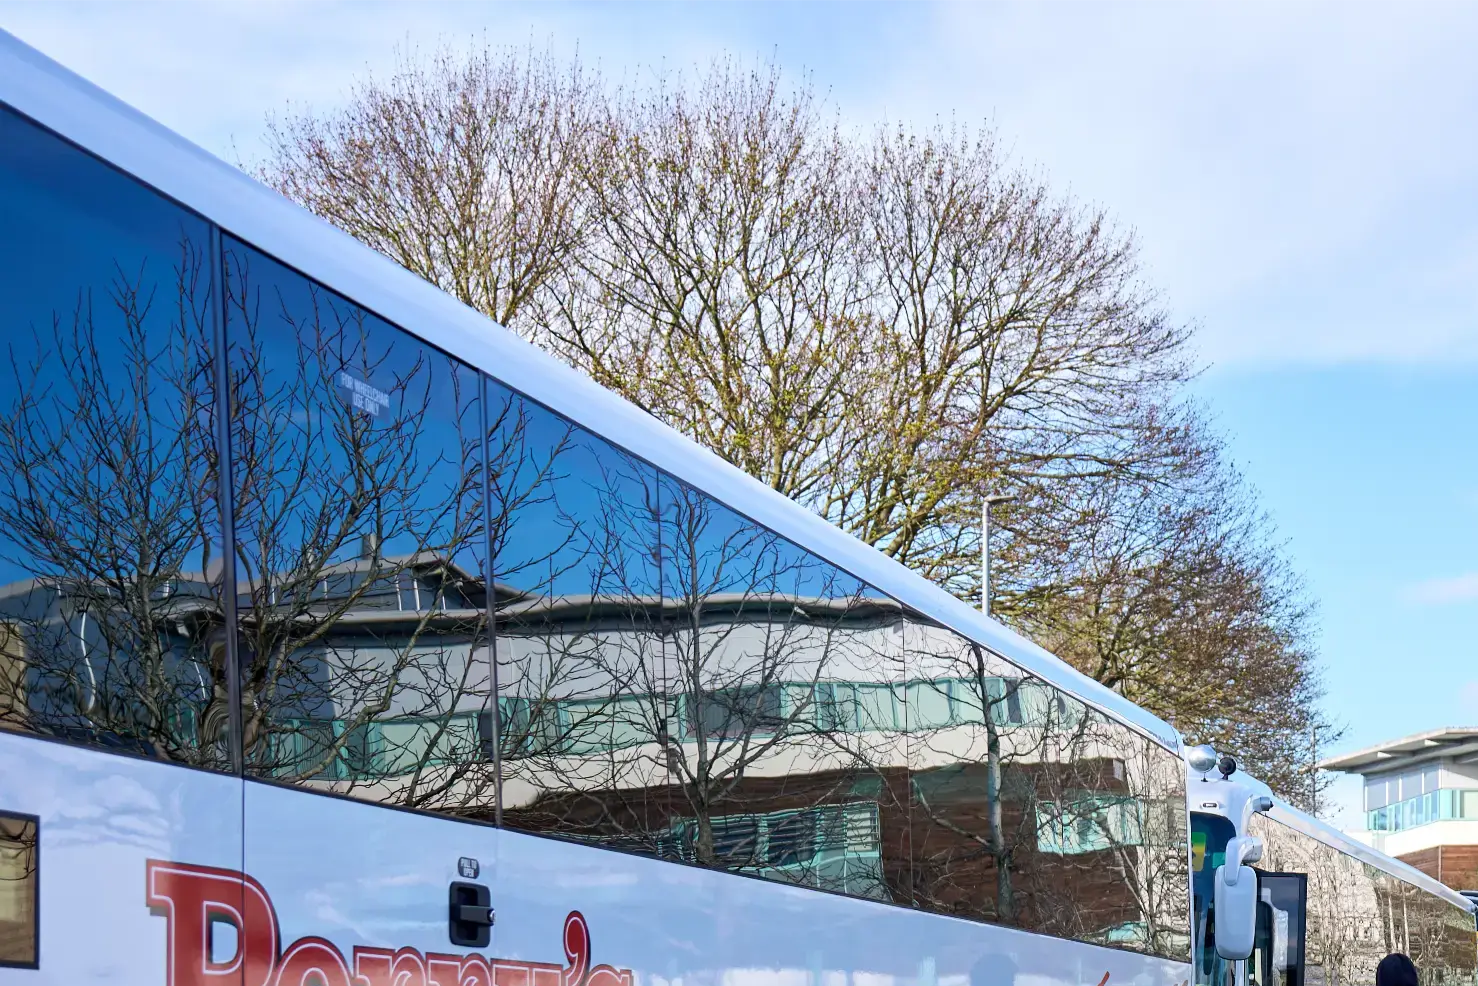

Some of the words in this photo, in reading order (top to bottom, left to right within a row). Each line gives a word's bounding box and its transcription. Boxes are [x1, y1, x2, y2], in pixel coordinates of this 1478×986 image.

[341, 371, 354, 390] FOR
[352, 391, 364, 410] USE
[365, 397, 380, 416] ONLY
